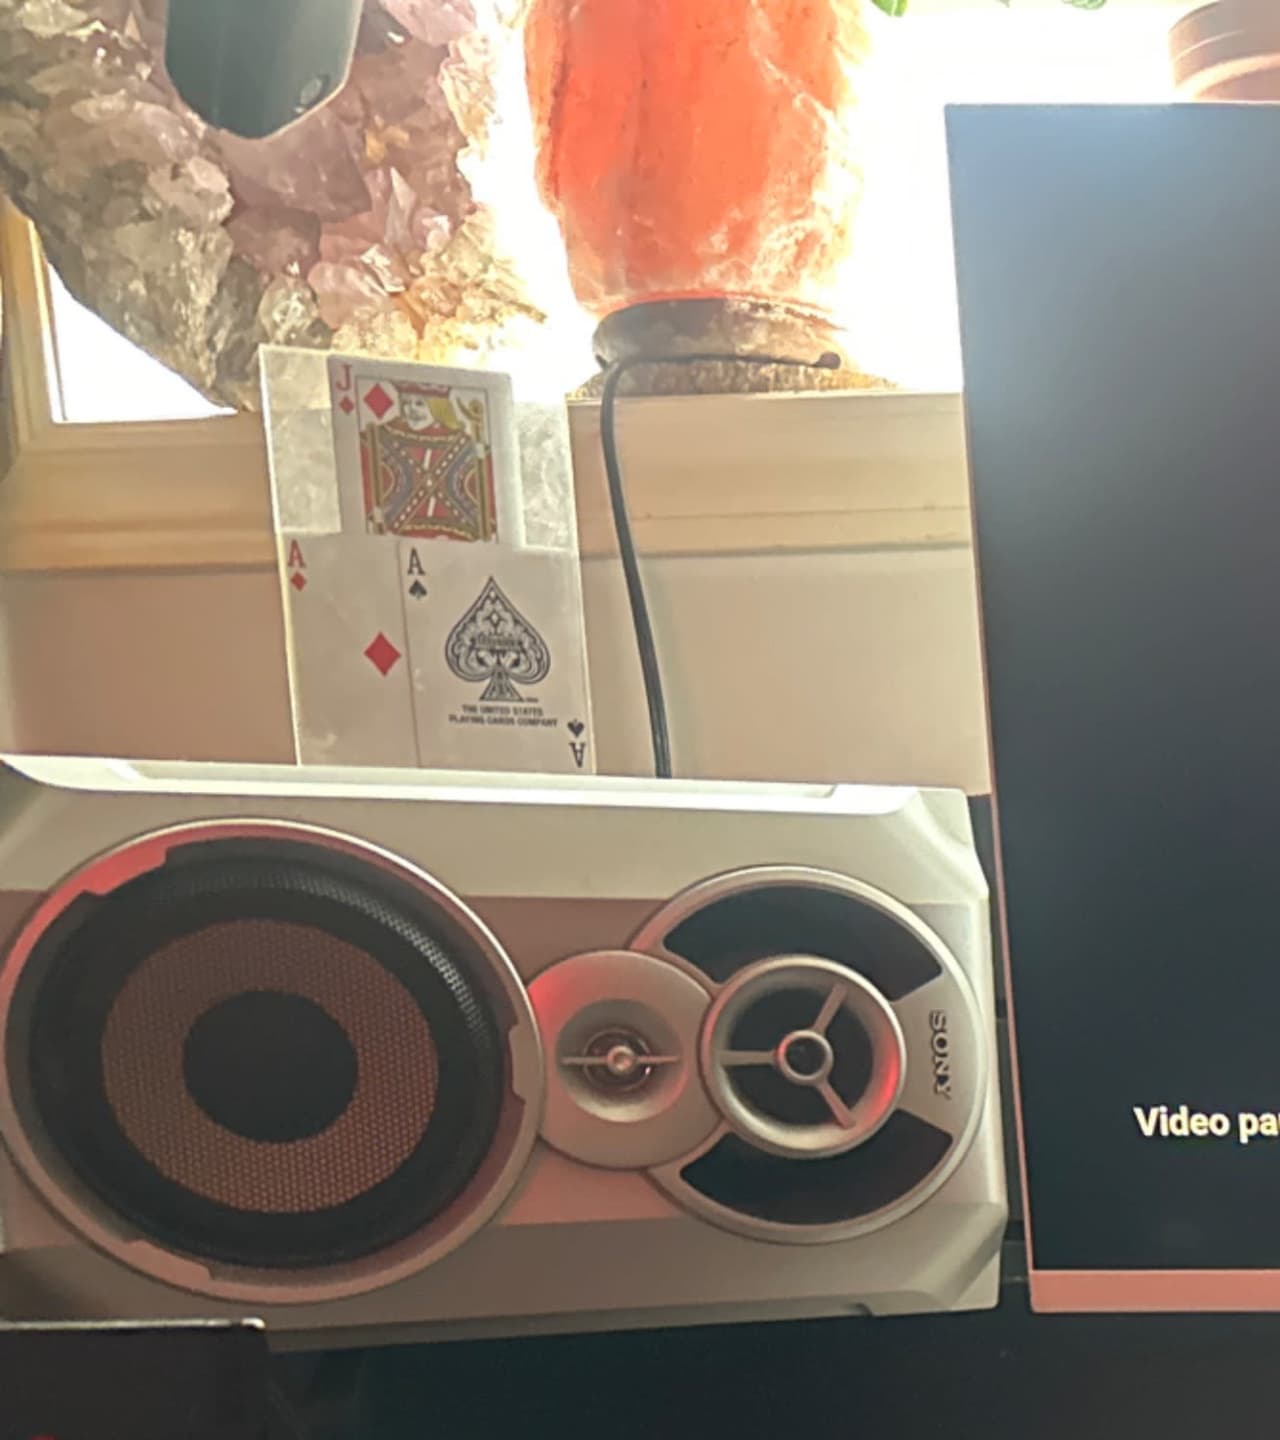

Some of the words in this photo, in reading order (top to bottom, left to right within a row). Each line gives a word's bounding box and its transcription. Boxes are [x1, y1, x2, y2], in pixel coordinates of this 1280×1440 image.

[336, 364, 353, 392] J
[287, 538, 307, 569] A
[407, 547, 426, 576] A
[569, 741, 586, 769] A
[929, 1009, 952, 1101] SONY
[1132, 1104, 1231, 1138] Video
